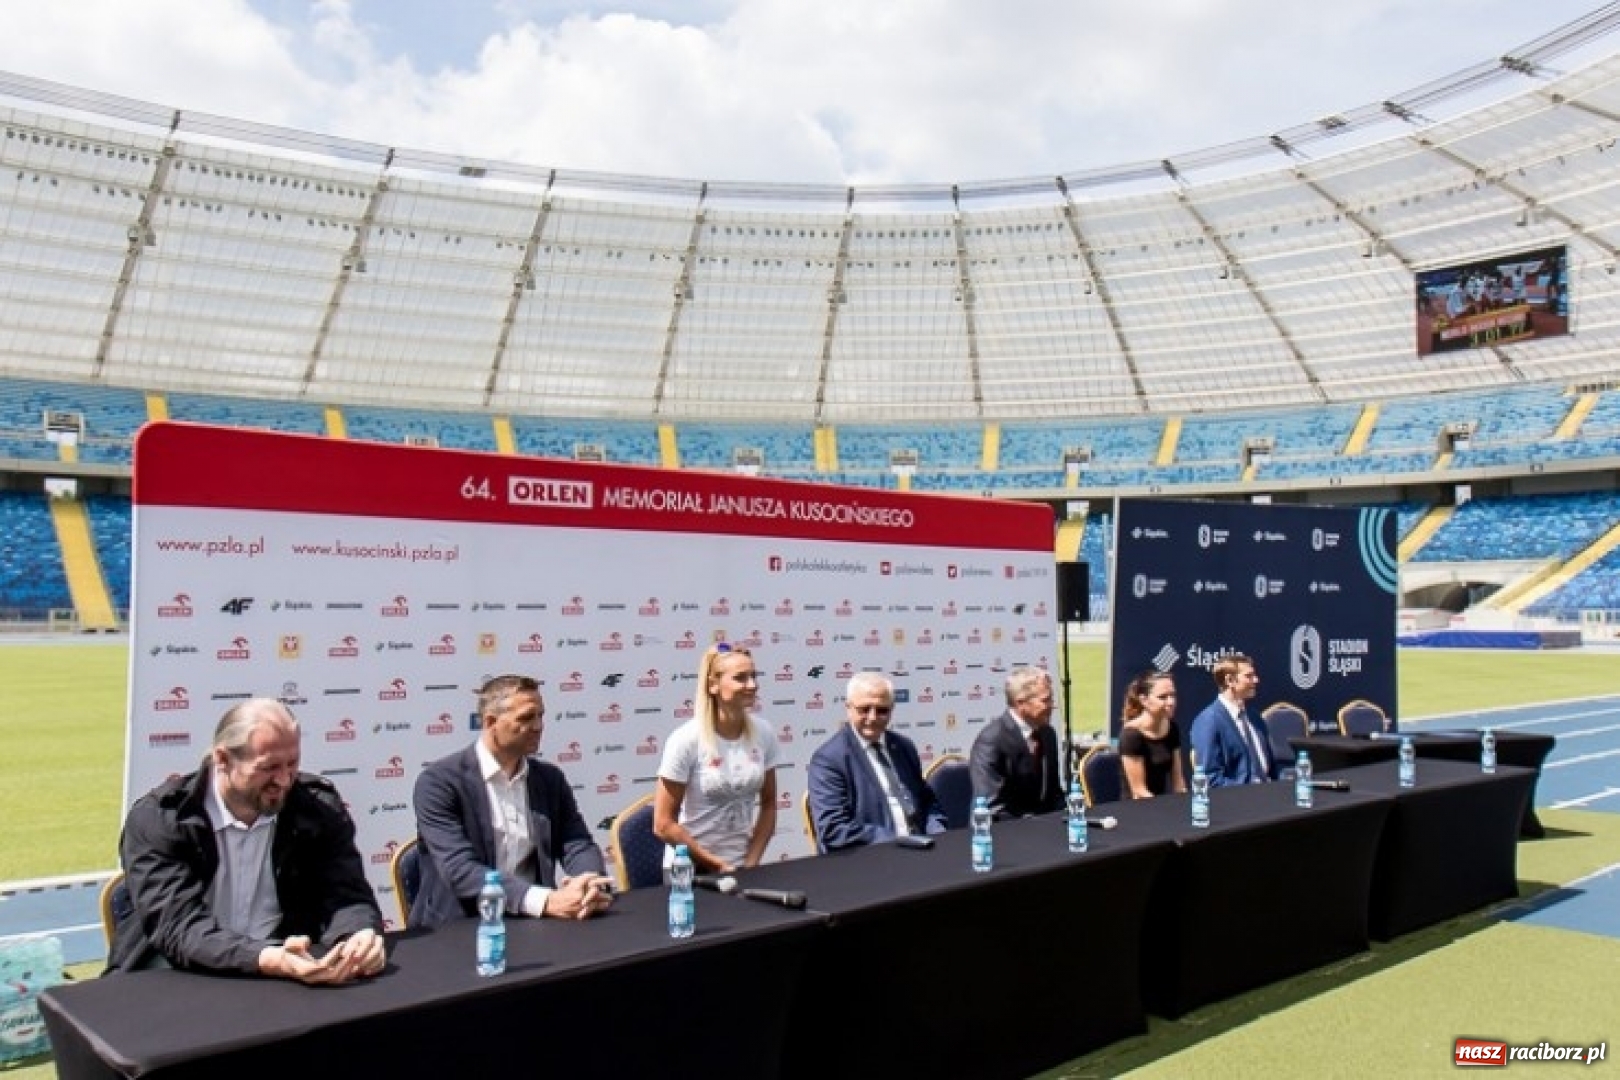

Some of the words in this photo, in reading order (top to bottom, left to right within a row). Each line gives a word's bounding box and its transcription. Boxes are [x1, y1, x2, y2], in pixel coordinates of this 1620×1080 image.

[460, 476, 497, 501] 64.
[513, 481, 588, 505] ORLEN
[602, 486, 704, 513] MEMORIAŁ
[707, 494, 787, 519] JANUSZA
[789, 500, 914, 528] KUSOCIŃSKIEGO
[156, 536, 264, 557] www.pzla.pl
[292, 540, 460, 562] www.kusocinski.pzla.pl
[220, 597, 254, 614] 4F
